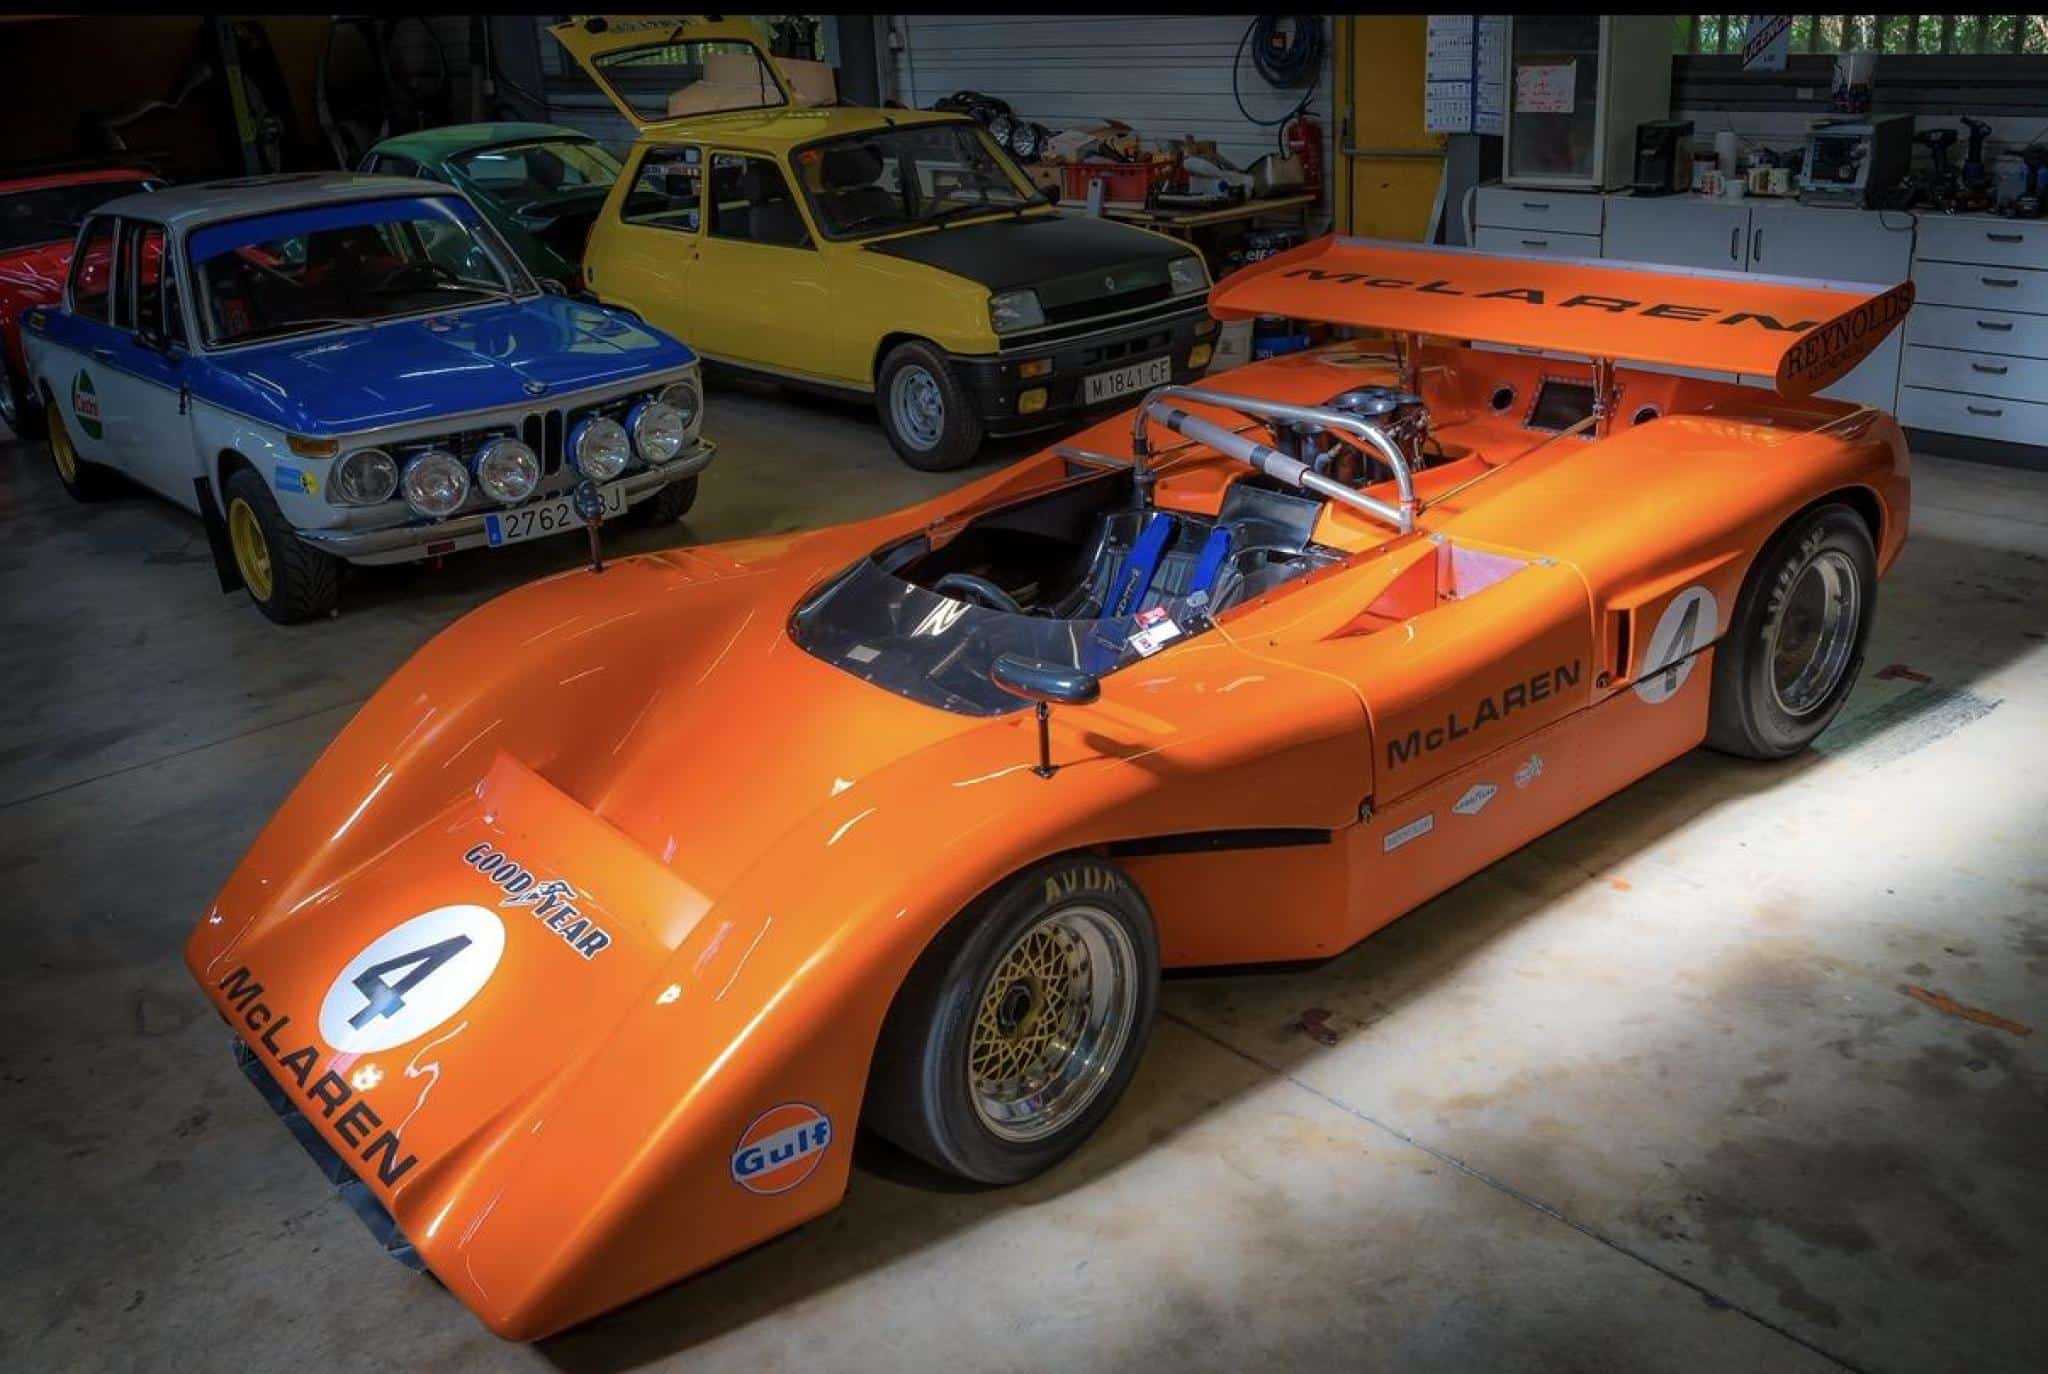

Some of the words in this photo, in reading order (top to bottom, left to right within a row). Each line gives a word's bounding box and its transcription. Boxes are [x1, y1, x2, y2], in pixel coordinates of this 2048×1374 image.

[1283, 268, 1817, 332] McLAREN
[1784, 281, 1914, 379] REYNOLDS
[505, 503, 570, 538] 2762
[1660, 598, 1700, 693] 4
[1386, 658, 1581, 771] McLAREN
[347, 934, 473, 1031] 4
[218, 966, 419, 1187] McLAREN
[735, 1121, 828, 1176] Gulf
